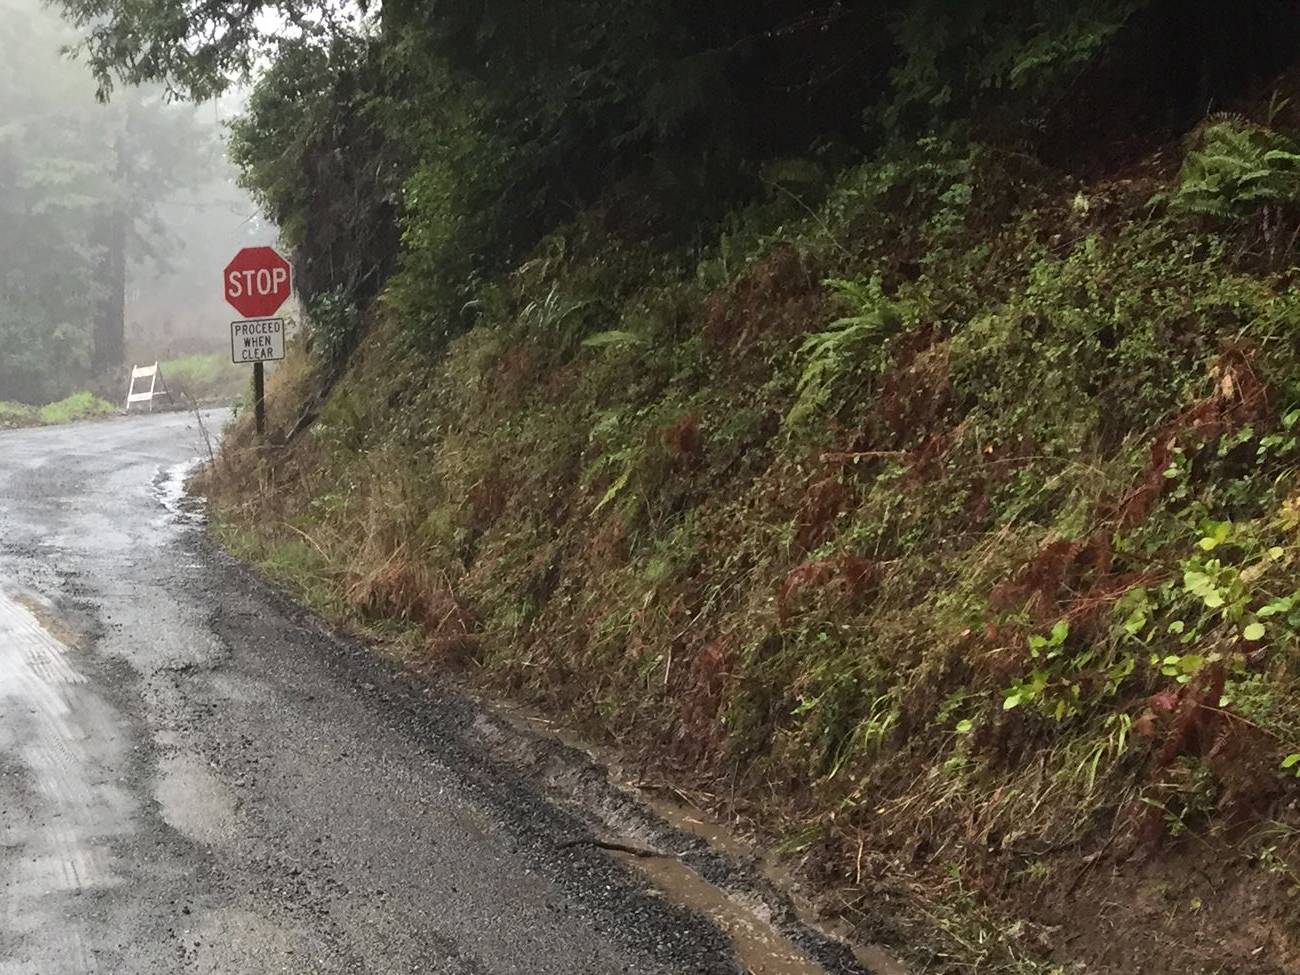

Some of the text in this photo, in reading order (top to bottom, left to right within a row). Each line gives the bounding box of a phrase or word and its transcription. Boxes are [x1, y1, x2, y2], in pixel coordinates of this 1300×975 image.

[228, 267, 287, 298] STOP
[234, 322, 280, 336] PROCEED
[243, 336, 271, 347] WHEN
[241, 349, 273, 360] CLEAR
